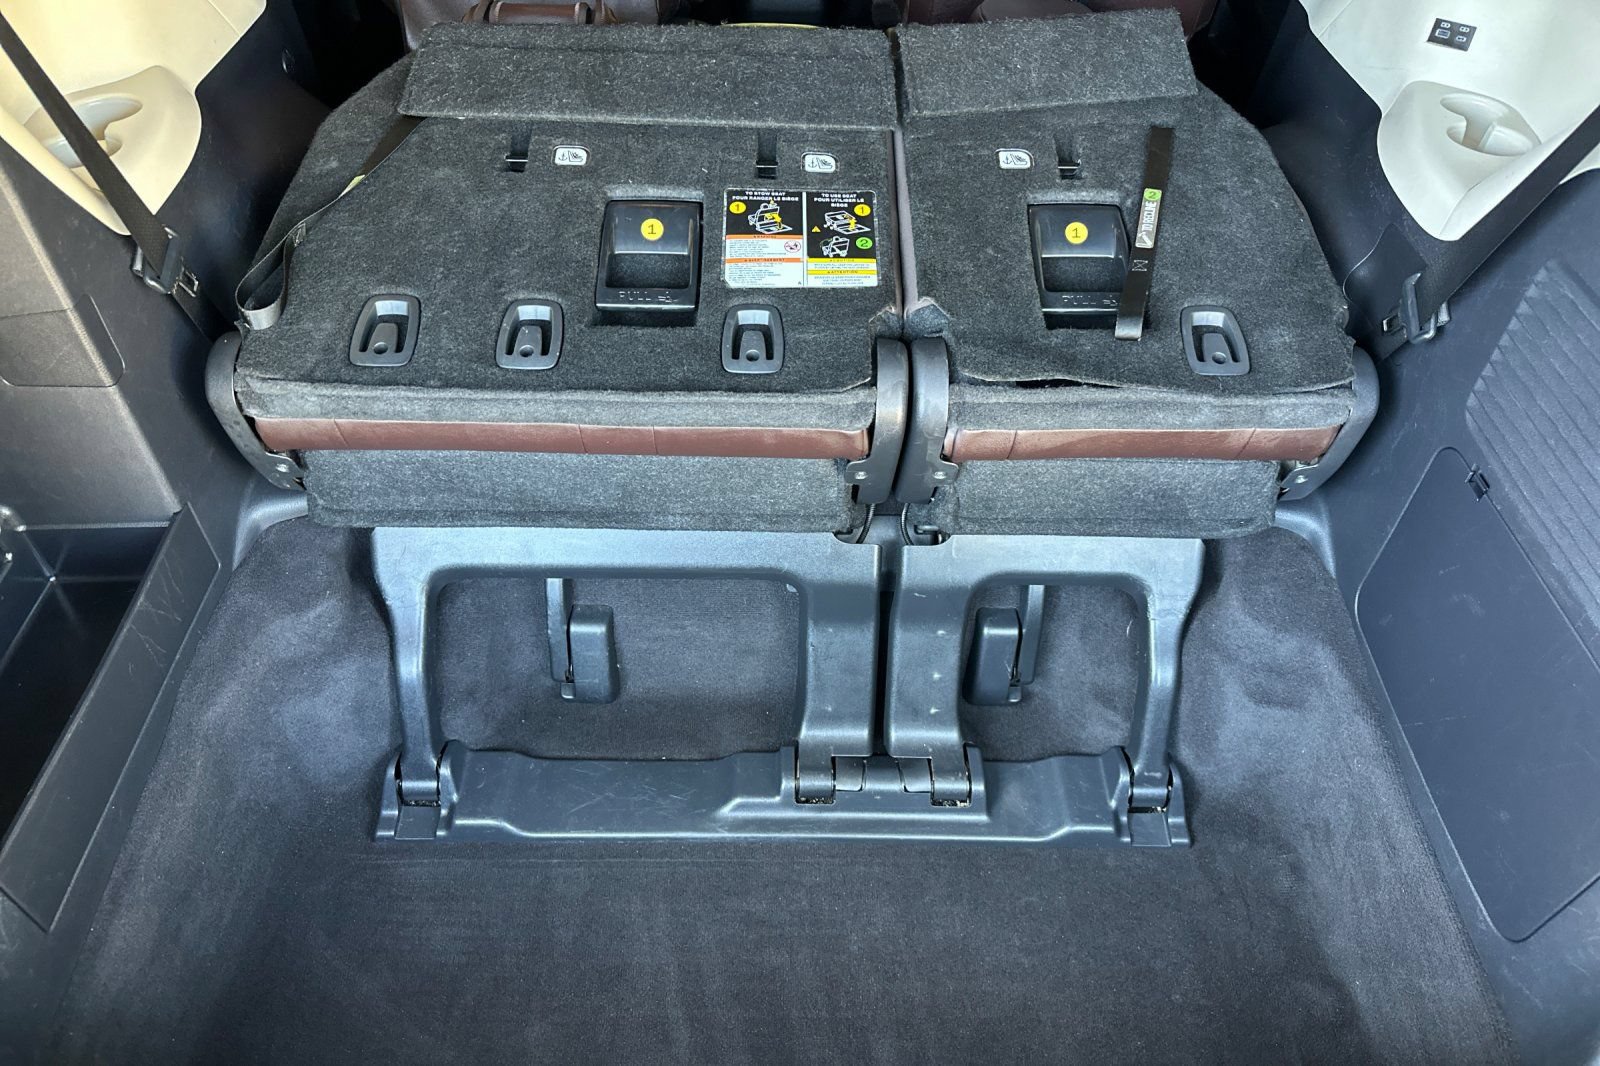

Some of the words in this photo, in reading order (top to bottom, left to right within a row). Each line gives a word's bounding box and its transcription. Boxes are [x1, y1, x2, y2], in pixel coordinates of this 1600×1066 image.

[1148, 191, 1156, 199] 2
[1142, 200, 1157, 224] RECLINE
[648, 224, 656, 235] 1
[1072, 227, 1082, 239] 1
[860, 238, 868, 248] 2
